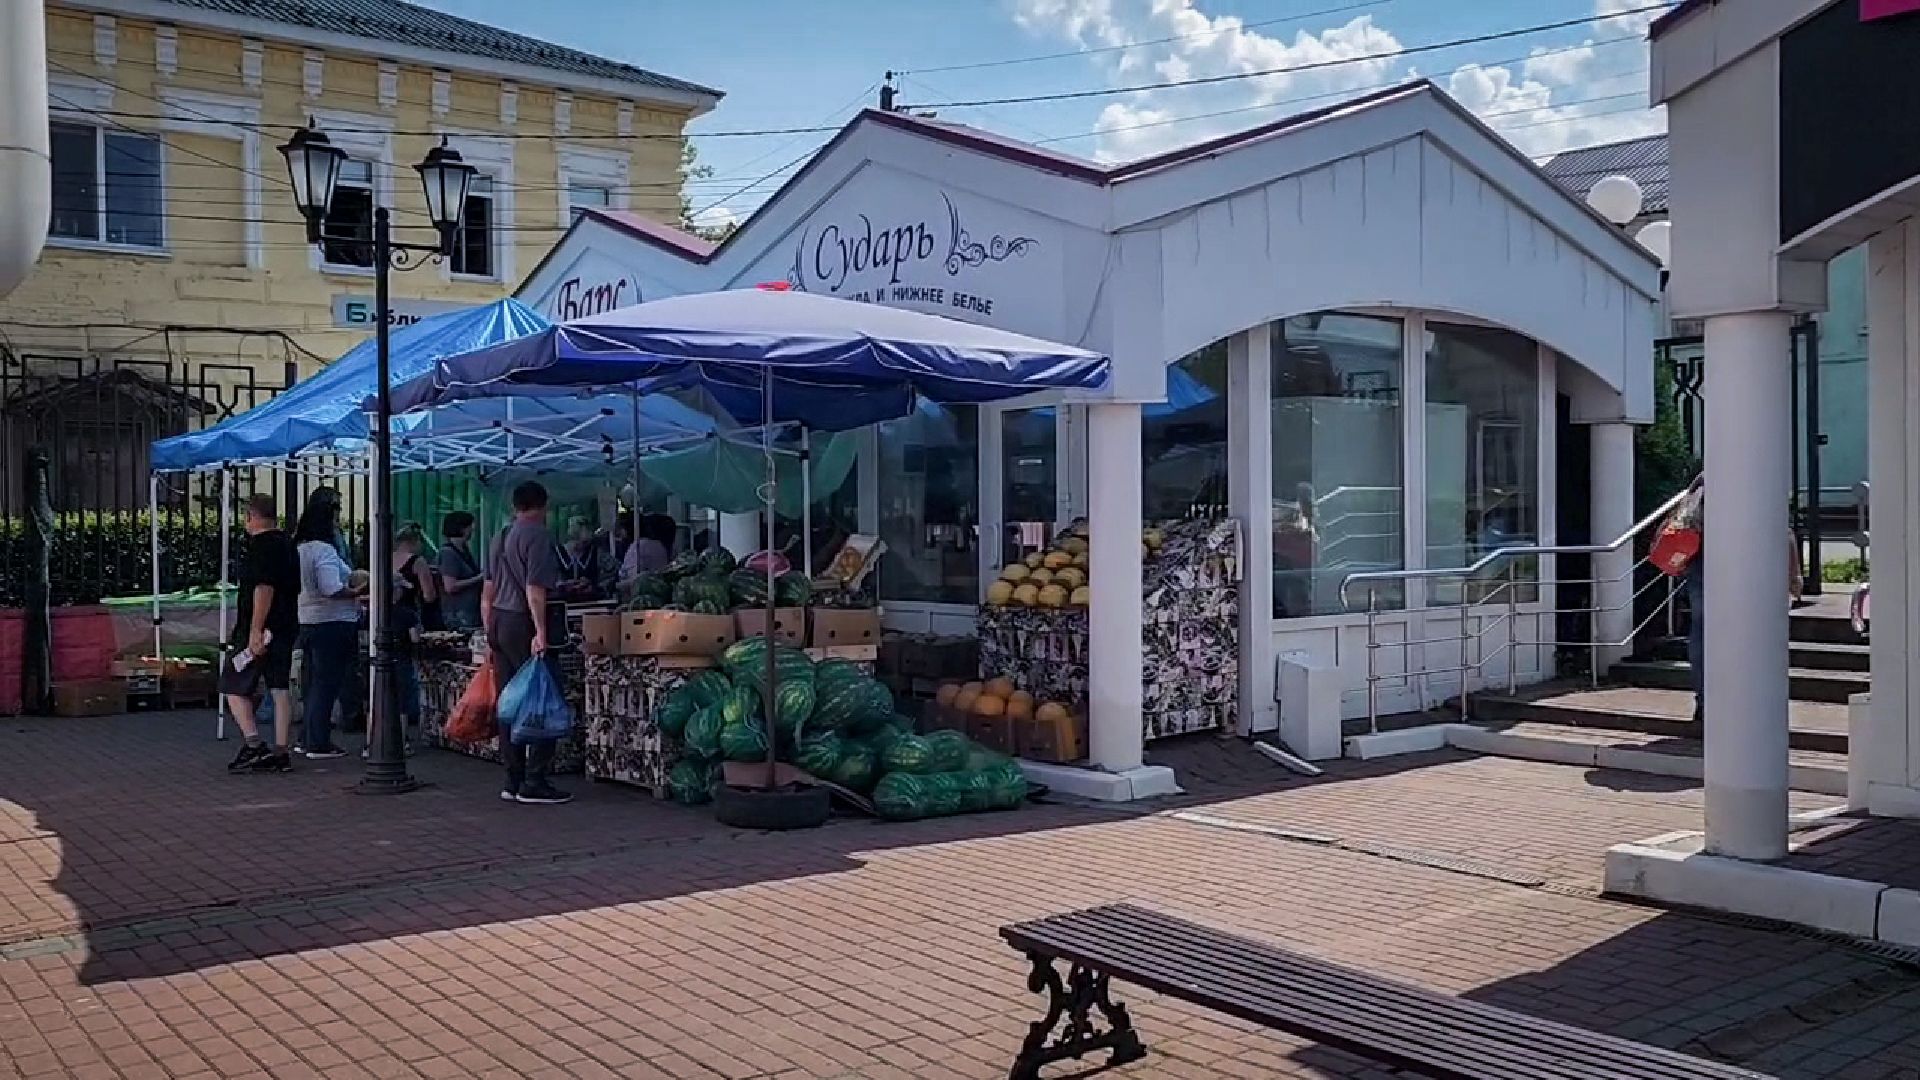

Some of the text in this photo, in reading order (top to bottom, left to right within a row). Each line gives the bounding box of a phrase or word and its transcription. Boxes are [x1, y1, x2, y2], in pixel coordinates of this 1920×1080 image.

[816, 213, 934, 292] Сударь
[876, 288, 886, 302] И
[893, 287, 944, 304] НИЖНЕЕ
[951, 291, 994, 316] БЕЛЬЕ
